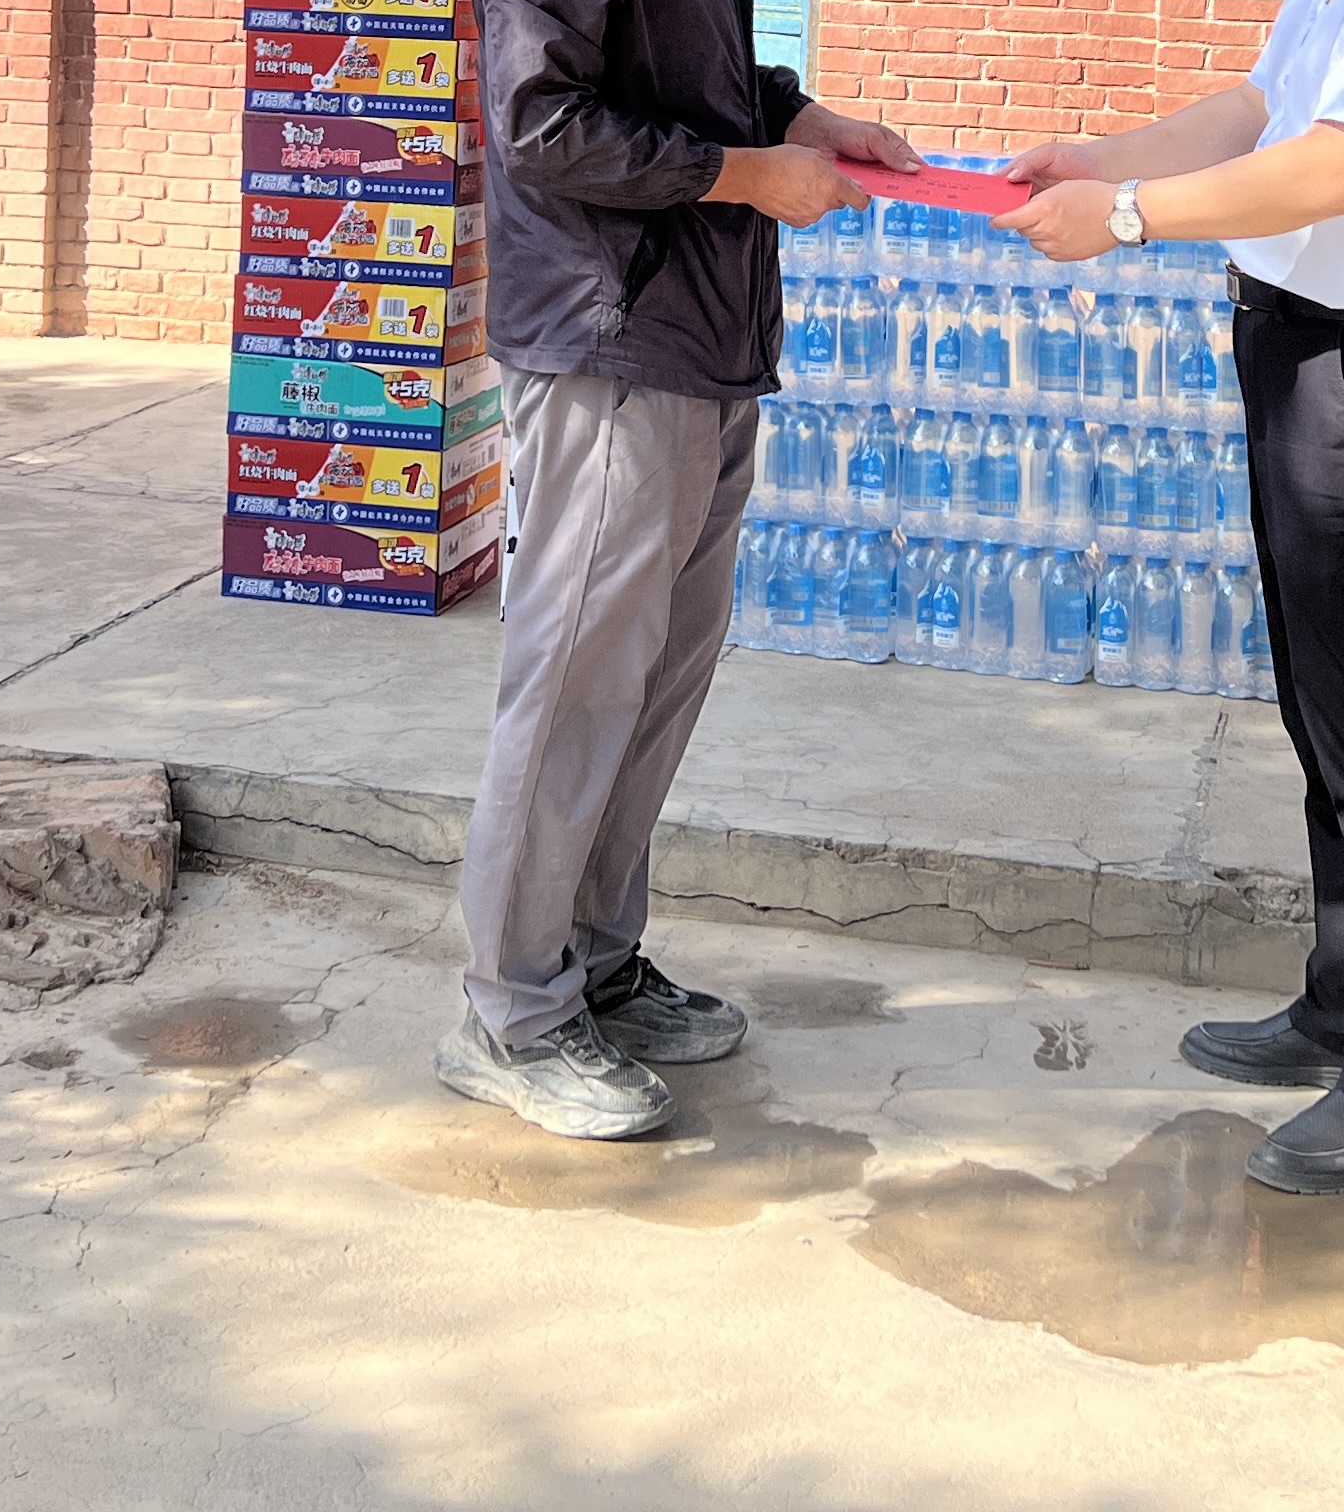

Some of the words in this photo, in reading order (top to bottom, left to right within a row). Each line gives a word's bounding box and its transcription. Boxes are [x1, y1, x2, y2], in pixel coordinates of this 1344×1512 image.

[255, 60, 313, 75] 红烧牛肉面
[401, 135, 443, 154] +5克
[251, 225, 309, 240] 红烧牛肉面
[244, 304, 302, 320] 红烧牛肉面
[281, 381, 321, 401] 藤椒
[388, 379, 431, 398] +5克
[239, 464, 297, 481] 红烧牛肉面
[383, 546, 425, 564] +5克
